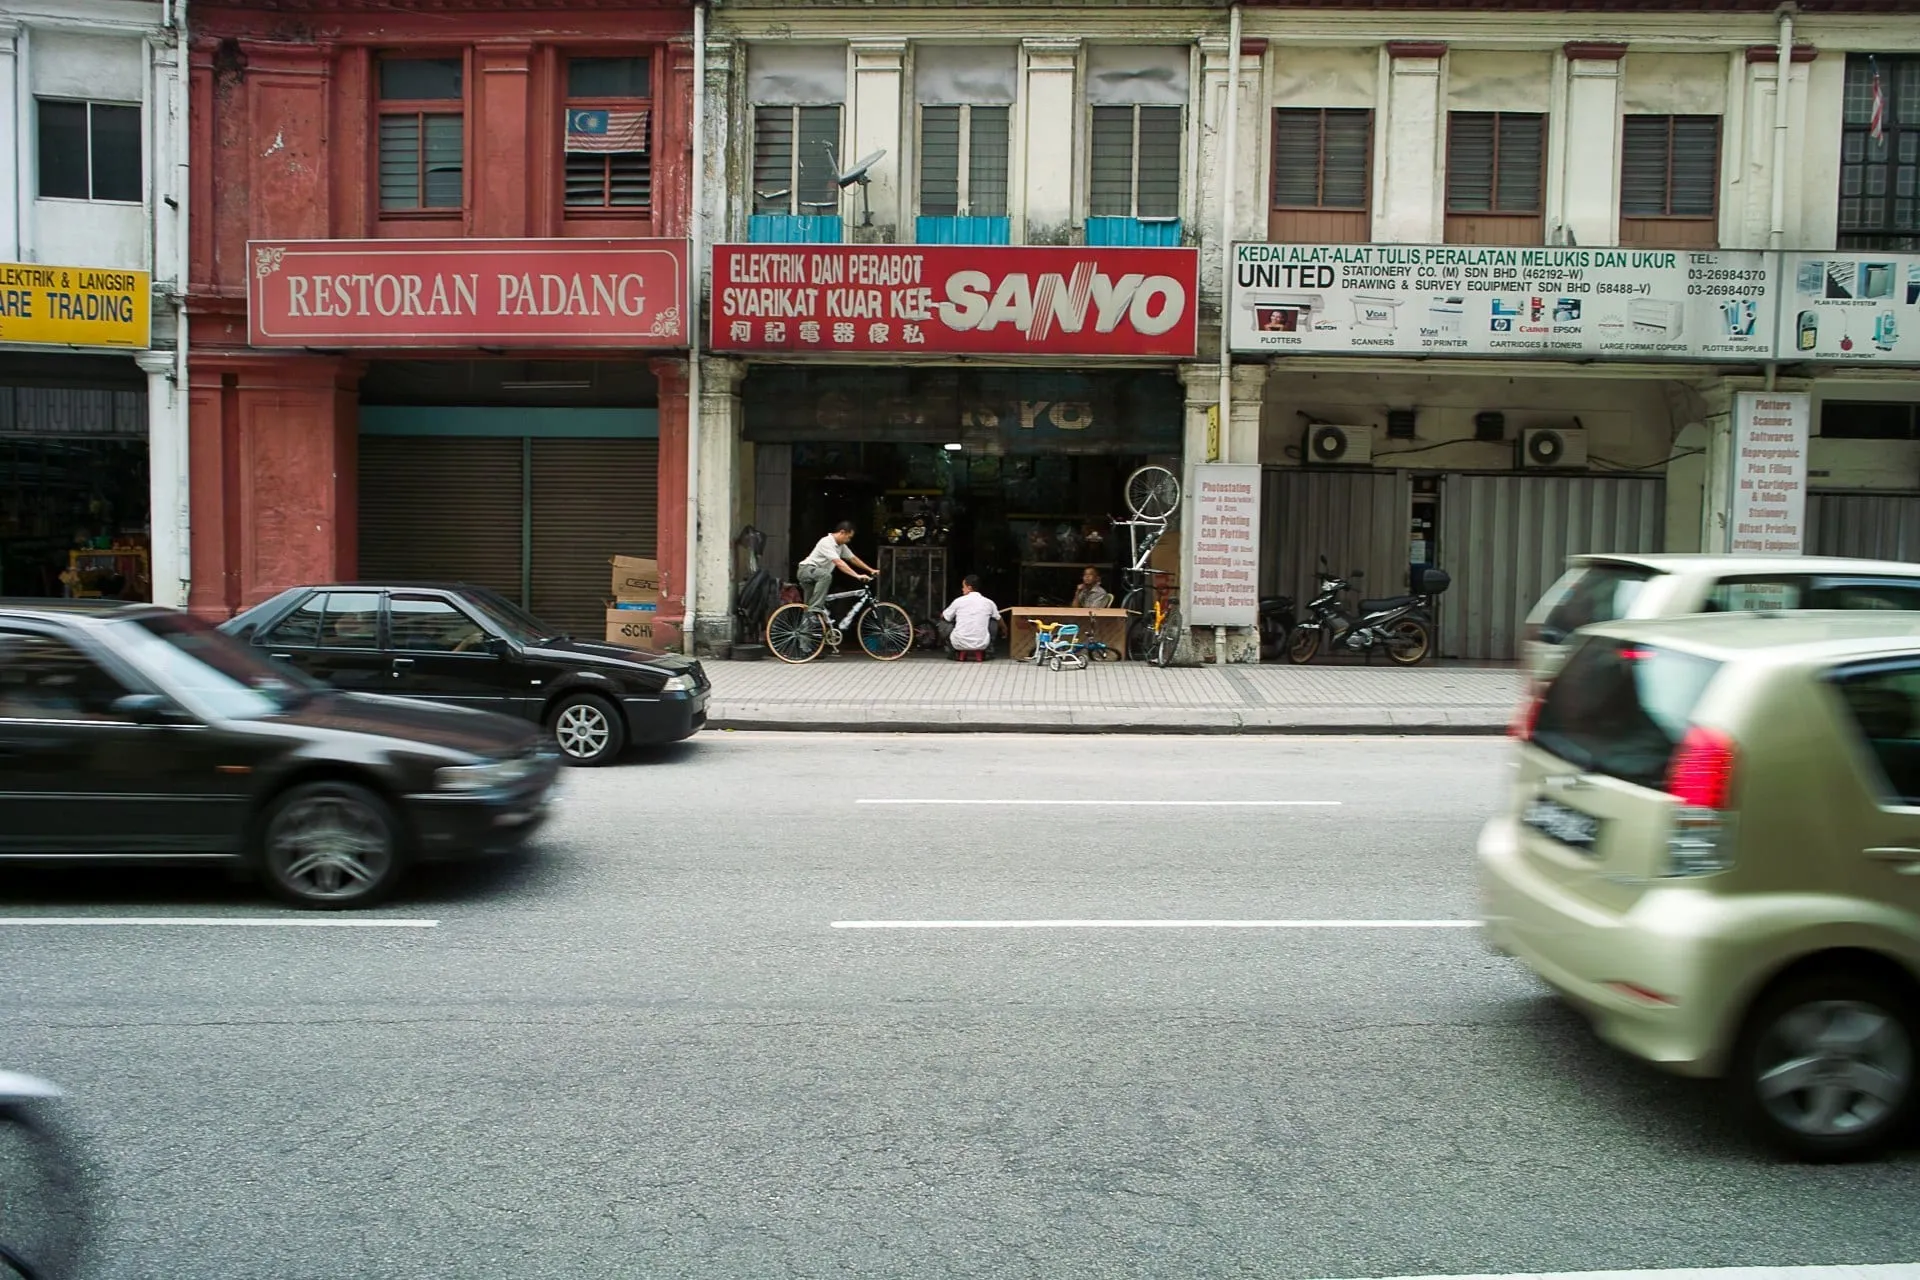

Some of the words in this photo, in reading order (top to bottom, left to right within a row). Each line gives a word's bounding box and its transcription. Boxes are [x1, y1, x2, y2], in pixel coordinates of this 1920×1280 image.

[1238, 246, 1285, 262] KEDAI
[1290, 247, 1373, 264] ALAT-ALAT
[1522, 250, 1589, 267] MELUKIS
[1595, 252, 1626, 268] DAN
[1632, 252, 1676, 268] UKUR
[1690, 253, 1718, 264] TEL:
[730, 253, 806, 283] ELEKTRIK
[811, 254, 843, 285] DAN
[849, 255, 924, 286] PERABOT
[1238, 263, 1335, 288] UNITED
[1342, 265, 1411, 276] STATIONERY
[1418, 267, 1437, 277] CO.
[1442, 267, 1459, 278] (M)
[1465, 267, 1488, 278] SDN
[1493, 268, 1517, 279] BHD
[1688, 269, 1766, 281] 03-26984370
[61, 272, 70, 288] &
[79, 273, 135, 291] LANGSIR
[1342, 279, 1396, 290] DRAWING
[1401, 280, 1408, 290] &
[1415, 280, 1461, 290] SURVEY
[1467, 281, 1532, 292] EQUIPMENT
[1538, 282, 1562, 292] SDN
[1567, 282, 1591, 293] BHD
[287, 273, 479, 317] RESTORAN
[497, 273, 647, 317] PADANG
[1687, 285, 1765, 296] 03-26984079
[46, 292, 133, 322] TRADING
[723, 287, 819, 317] SYARIKAT
[826, 288, 882, 319] KUAR
[891, 287, 933, 320] KEE
[939, 261, 1186, 341] SANYO
[1553, 326, 1582, 334] EPSON
[1261, 337, 1302, 345] PLOTTERS
[1351, 338, 1395, 346] SCANNERS
[1433, 339, 1468, 347] PRINTER
[1489, 340, 1541, 348] CARTRIDGES
[1551, 341, 1583, 349] TONERS
[1600, 342, 1624, 350] LARGE
[1656, 343, 1687, 351] COPIERS
[1735, 345, 1769, 353] SUPPLIES
[1755, 399, 1791, 410] Plotters
[1752, 415, 1792, 426] Scanners
[1750, 431, 1794, 442] Softwares
[1742, 447, 1800, 459] Reprographic
[1748, 463, 1766, 474] Plan
[1202, 481, 1251, 495] Photostating
[1201, 515, 1218, 525] Plan
[1220, 515, 1250, 528] Printing
[1201, 528, 1216, 538] CAD
[1220, 528, 1249, 541] Plotting
[1765, 523, 1797, 536] Printing
[1197, 541, 1229, 554] Scanning
[1194, 555, 1232, 567] Laminating
